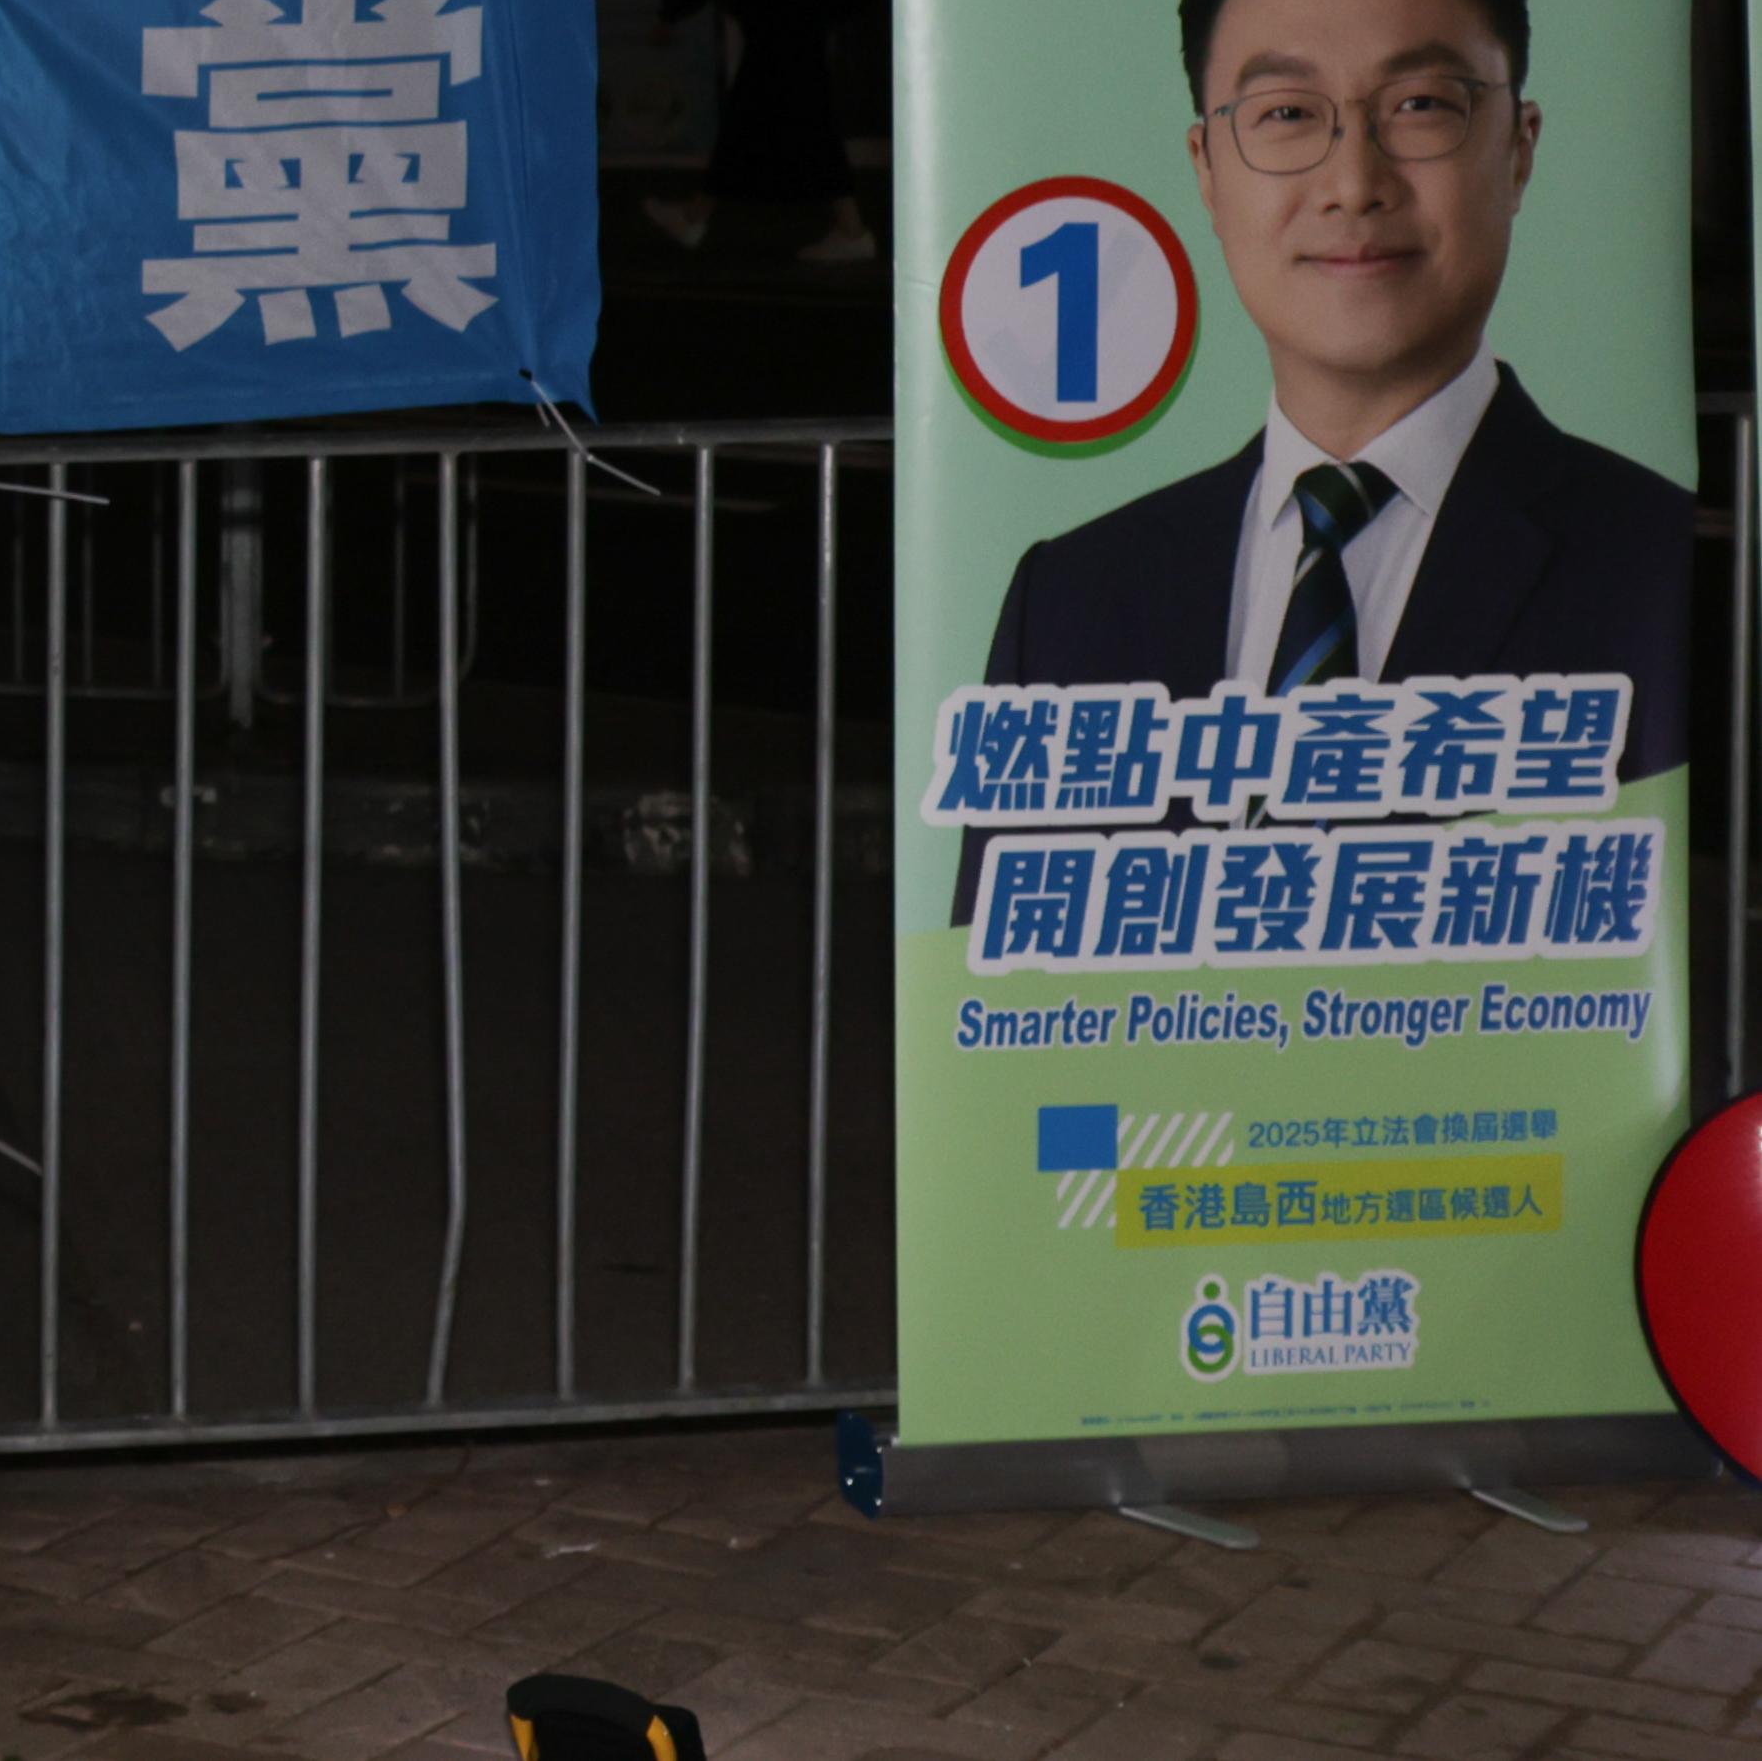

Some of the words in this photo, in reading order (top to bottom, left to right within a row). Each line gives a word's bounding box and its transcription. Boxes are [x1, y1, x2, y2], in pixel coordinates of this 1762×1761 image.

[1019, 222, 1099, 403] 1
[937, 689, 1620, 811] 燃點中產希望
[982, 833, 1653, 960] 開創發展新機
[958, 998, 1115, 1048] Smarter
[1128, 993, 1288, 1050] Policies,
[1303, 989, 1468, 1047] Stronger
[1481, 984, 1650, 1039] Economy
[1249, 1110, 1557, 1148] 2025年立法會換屆選舉
[1139, 1180, 1543, 1230] 香港島西地方選區候選人
[1251, 1276, 1414, 1340] 自由黨
[1251, 1345, 1340, 1368] LIBERAL
[1345, 1341, 1411, 1365] PARTY
